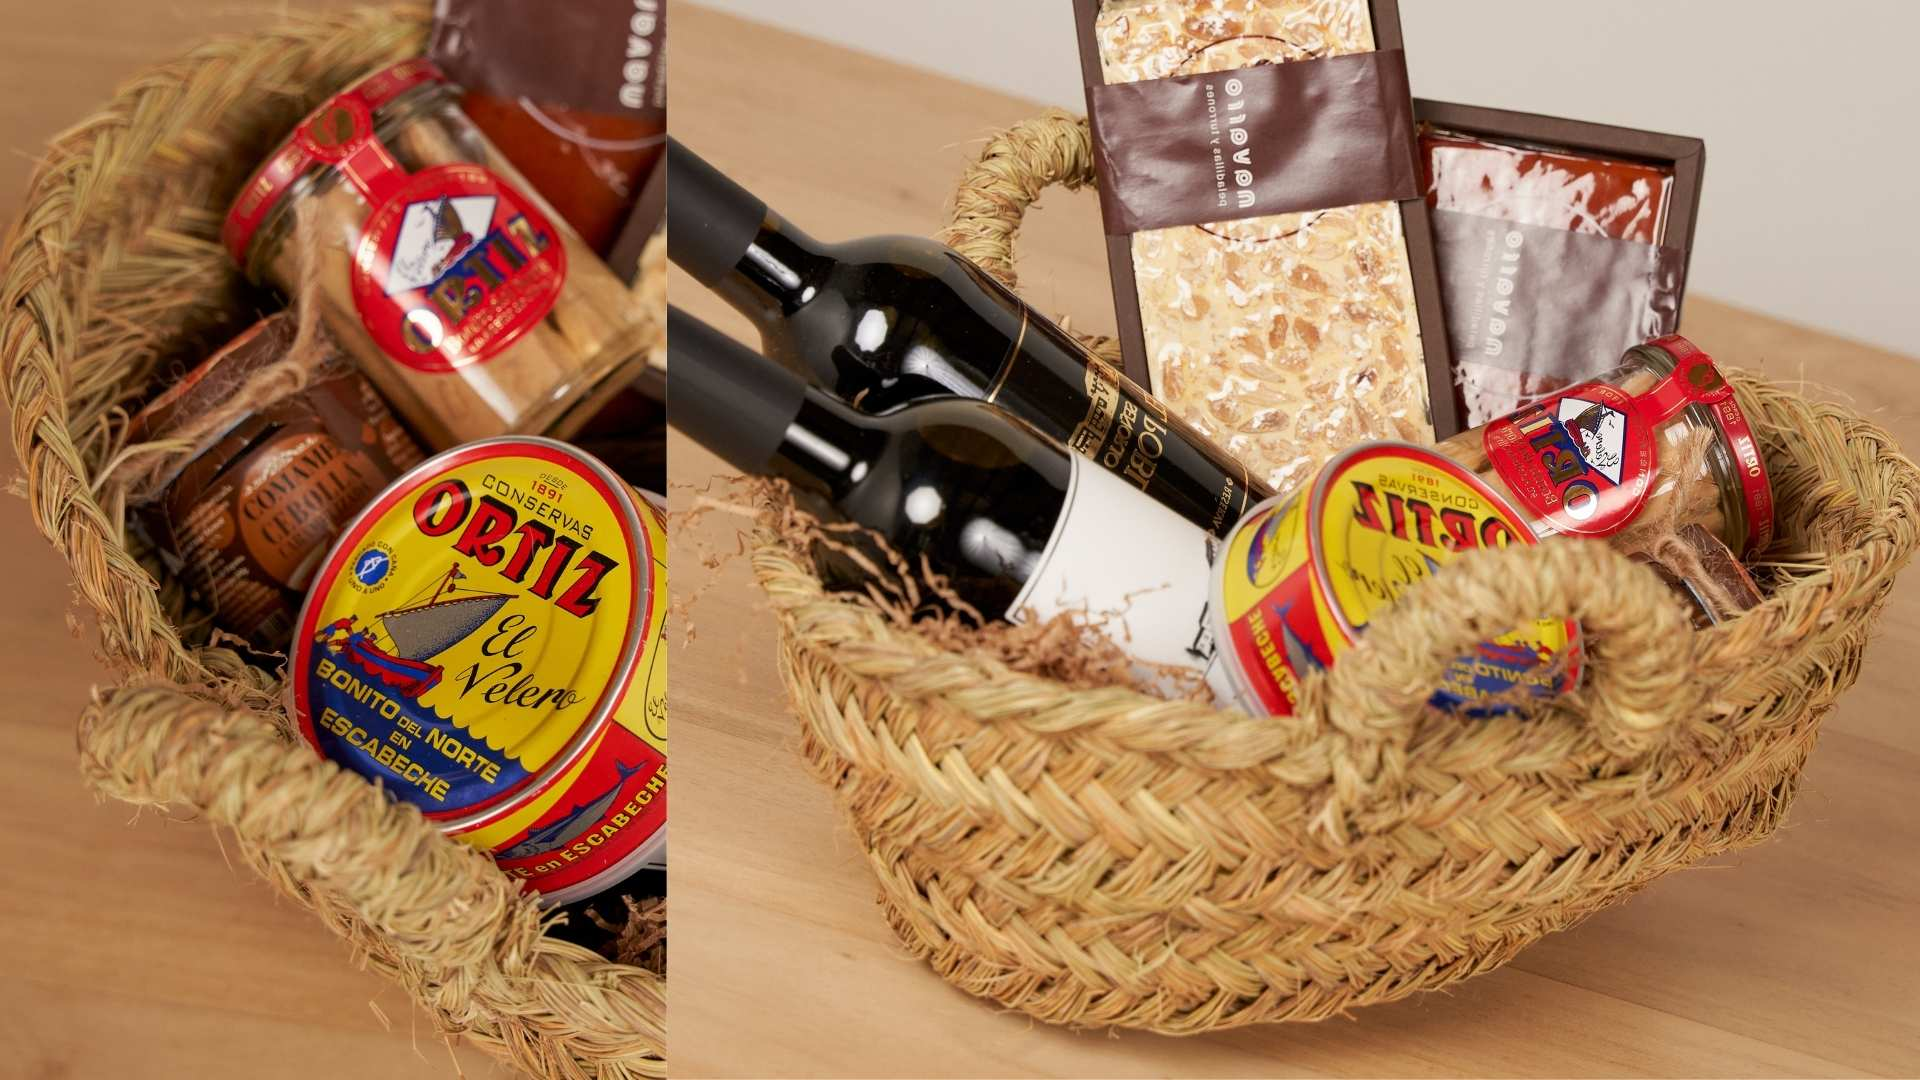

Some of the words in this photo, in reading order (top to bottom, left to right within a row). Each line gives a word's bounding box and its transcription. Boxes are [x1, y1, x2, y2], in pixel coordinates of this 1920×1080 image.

[618, 0, 658, 109] navar
[402, 212, 550, 353] ORTIZ
[482, 474, 593, 541] CONSERVAS
[531, 480, 563, 503] 1891
[412, 478, 619, 618] ORTIZ
[482, 613, 537, 659] El
[455, 662, 586, 709] Velero
[315, 658, 401, 720] BONITO
[397, 715, 422, 739] DEL
[425, 727, 501, 785] NORTE
[319, 706, 451, 802] ESCABECHE
[389, 730, 412, 750] EN
[534, 859, 562, 873] en
